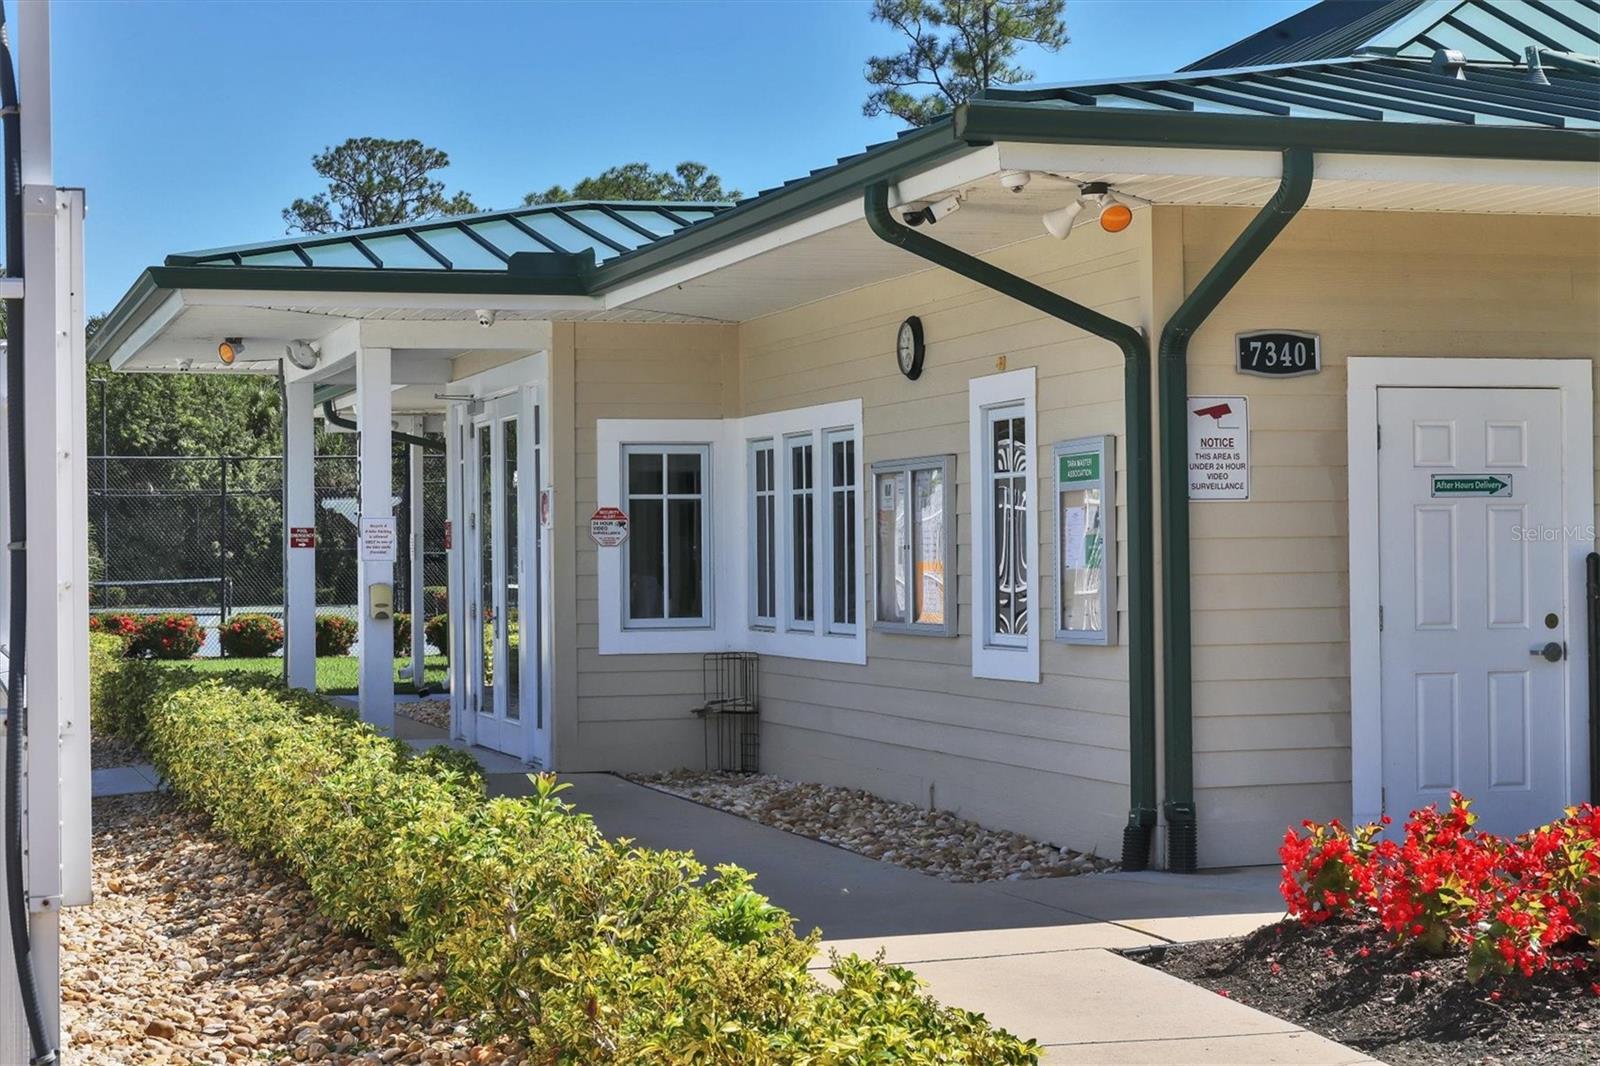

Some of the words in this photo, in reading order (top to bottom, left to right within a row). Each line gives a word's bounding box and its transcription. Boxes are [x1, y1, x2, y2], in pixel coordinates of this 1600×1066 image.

[1249, 341, 1307, 367] 7340
[1200, 437, 1234, 448] NOTICE
[1206, 472, 1229, 480] VIDEO
[1191, 482, 1244, 490] SURVEILLANCE
[1436, 481, 1454, 489] After
[1454, 481, 1474, 489] Hours
[1475, 481, 1502, 490] Delivery
